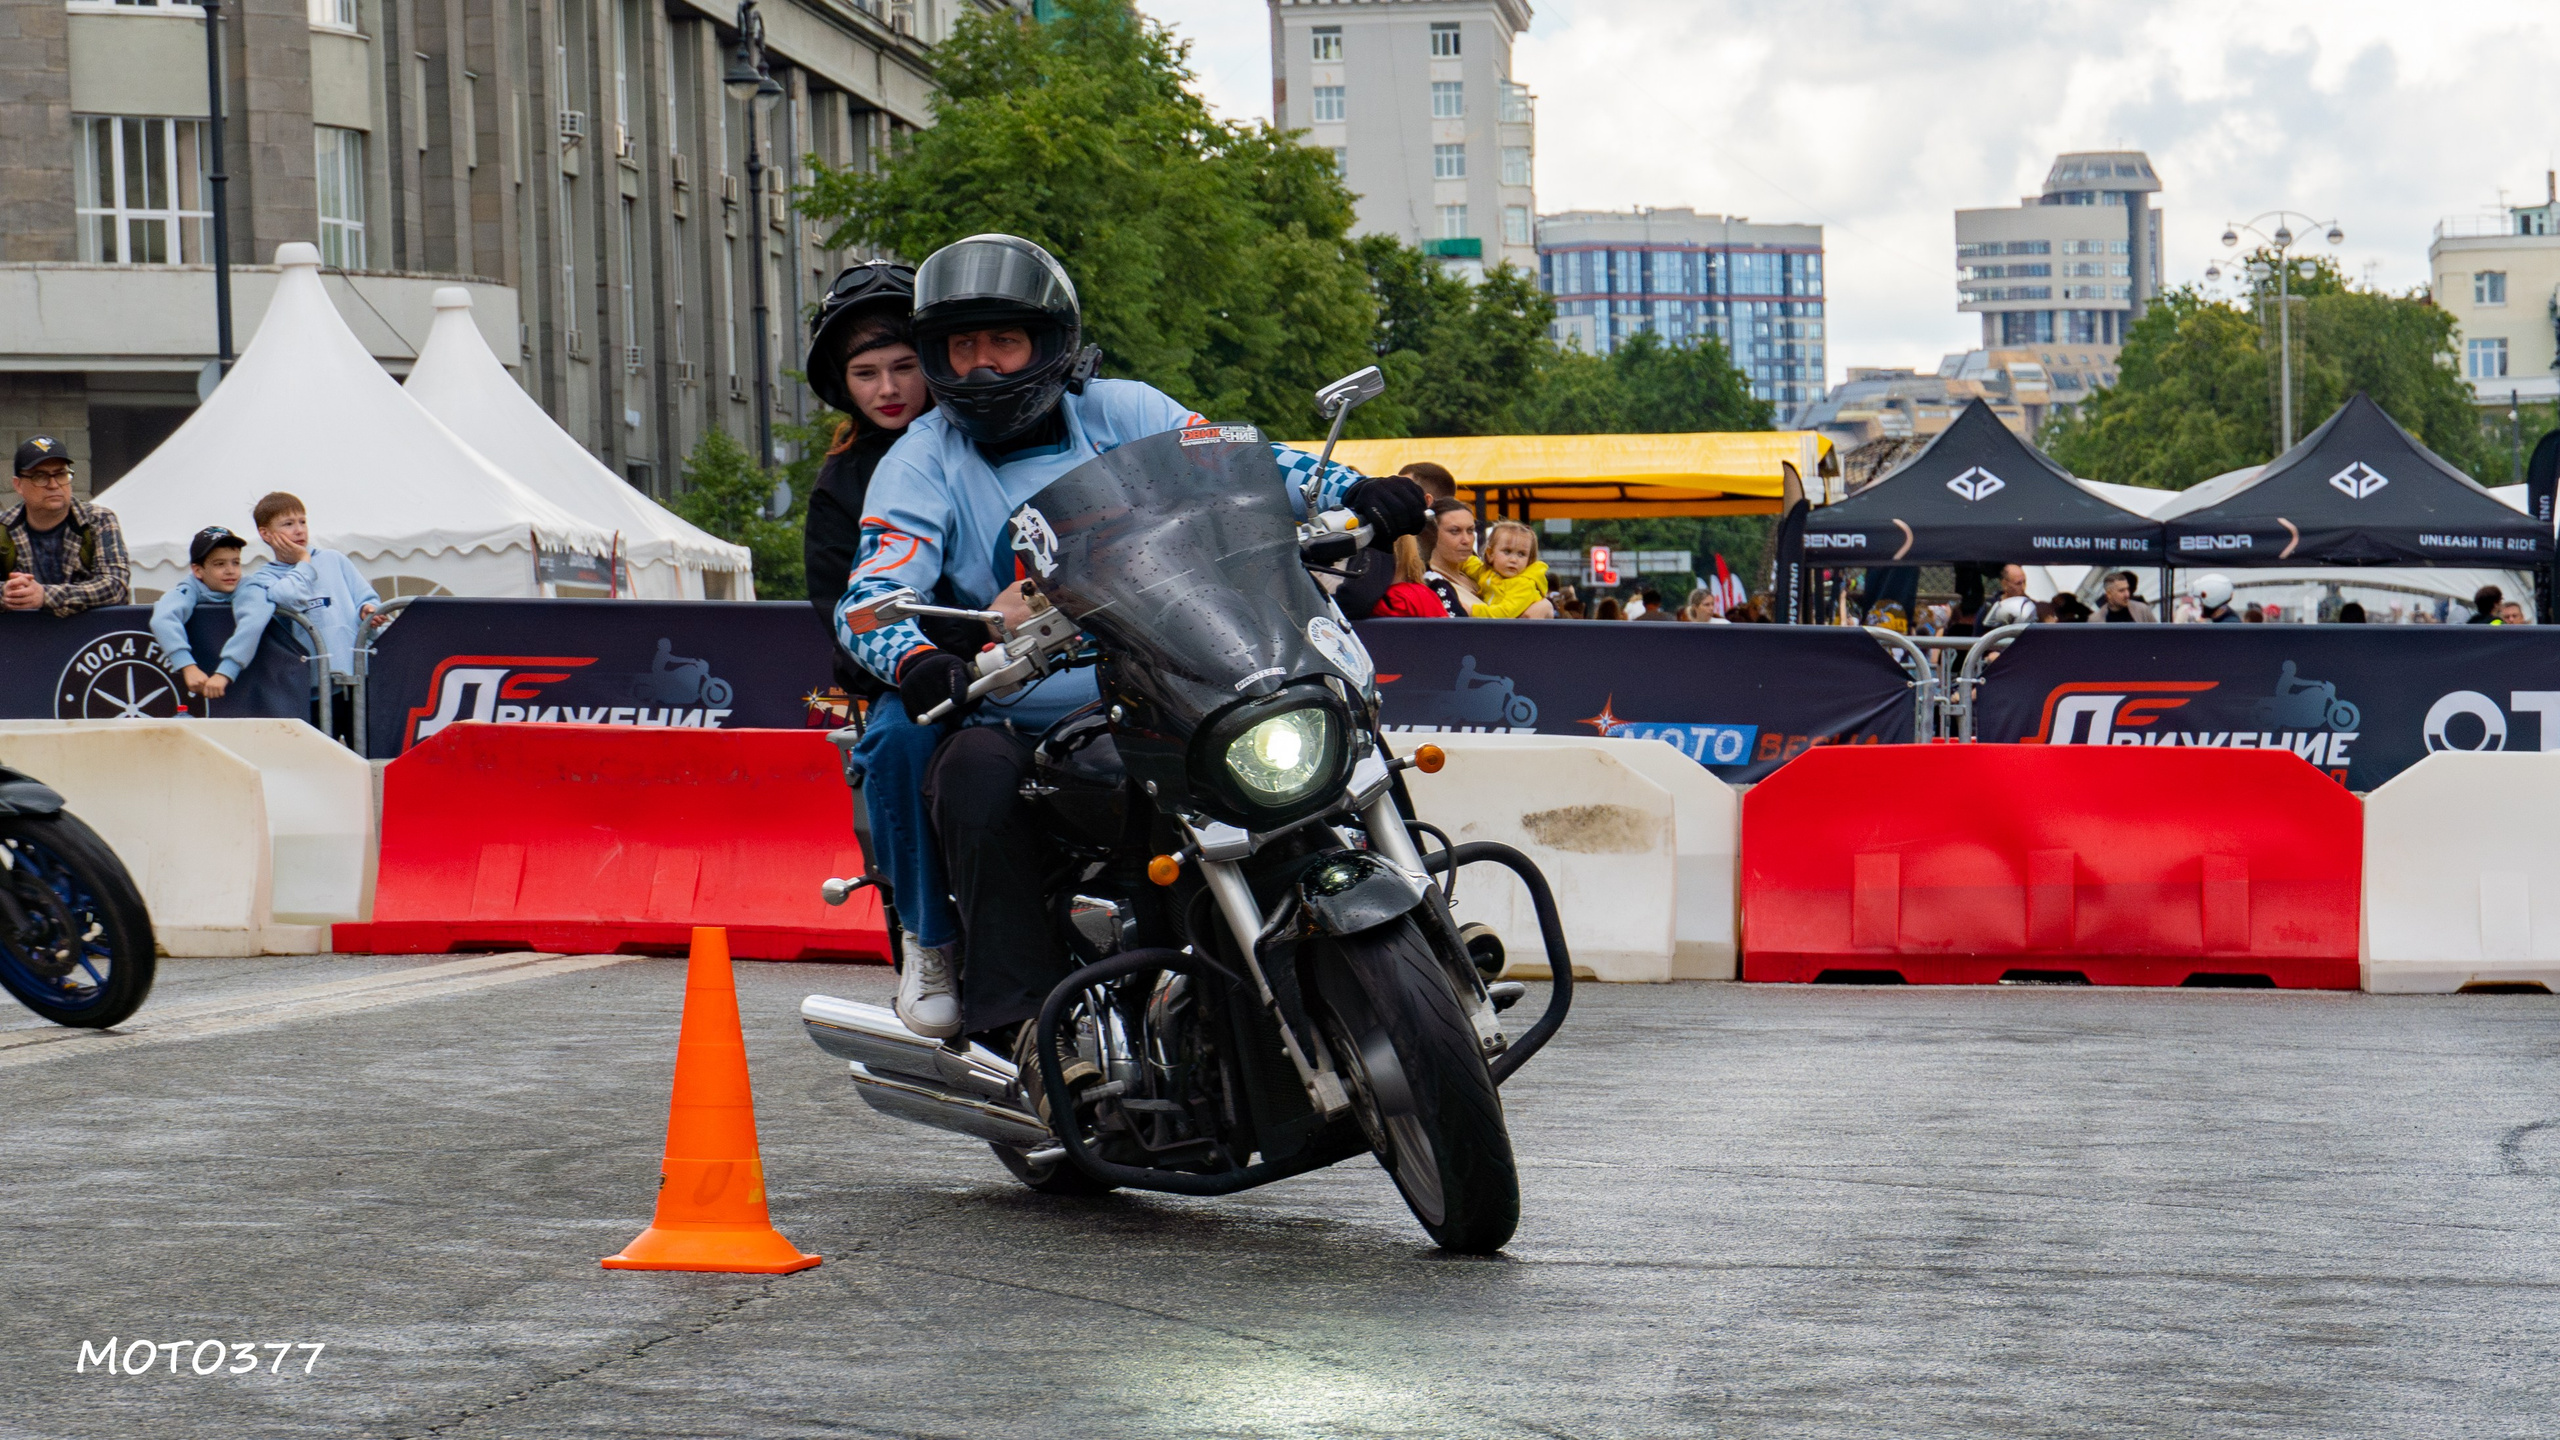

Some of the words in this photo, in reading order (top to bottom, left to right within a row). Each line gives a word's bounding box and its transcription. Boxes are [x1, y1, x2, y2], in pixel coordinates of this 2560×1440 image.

[2033, 536, 2091, 550] UNLEASH
[2094, 537, 2117, 550] THE
[2120, 538, 2149, 552] RIDE
[2179, 535, 2252, 550] BENDA
[2419, 534, 2478, 549] UNLEASH
[2481, 536, 2504, 550] THE
[2507, 537, 2537, 551] RIDE
[76, 638, 136, 677] 100.4
